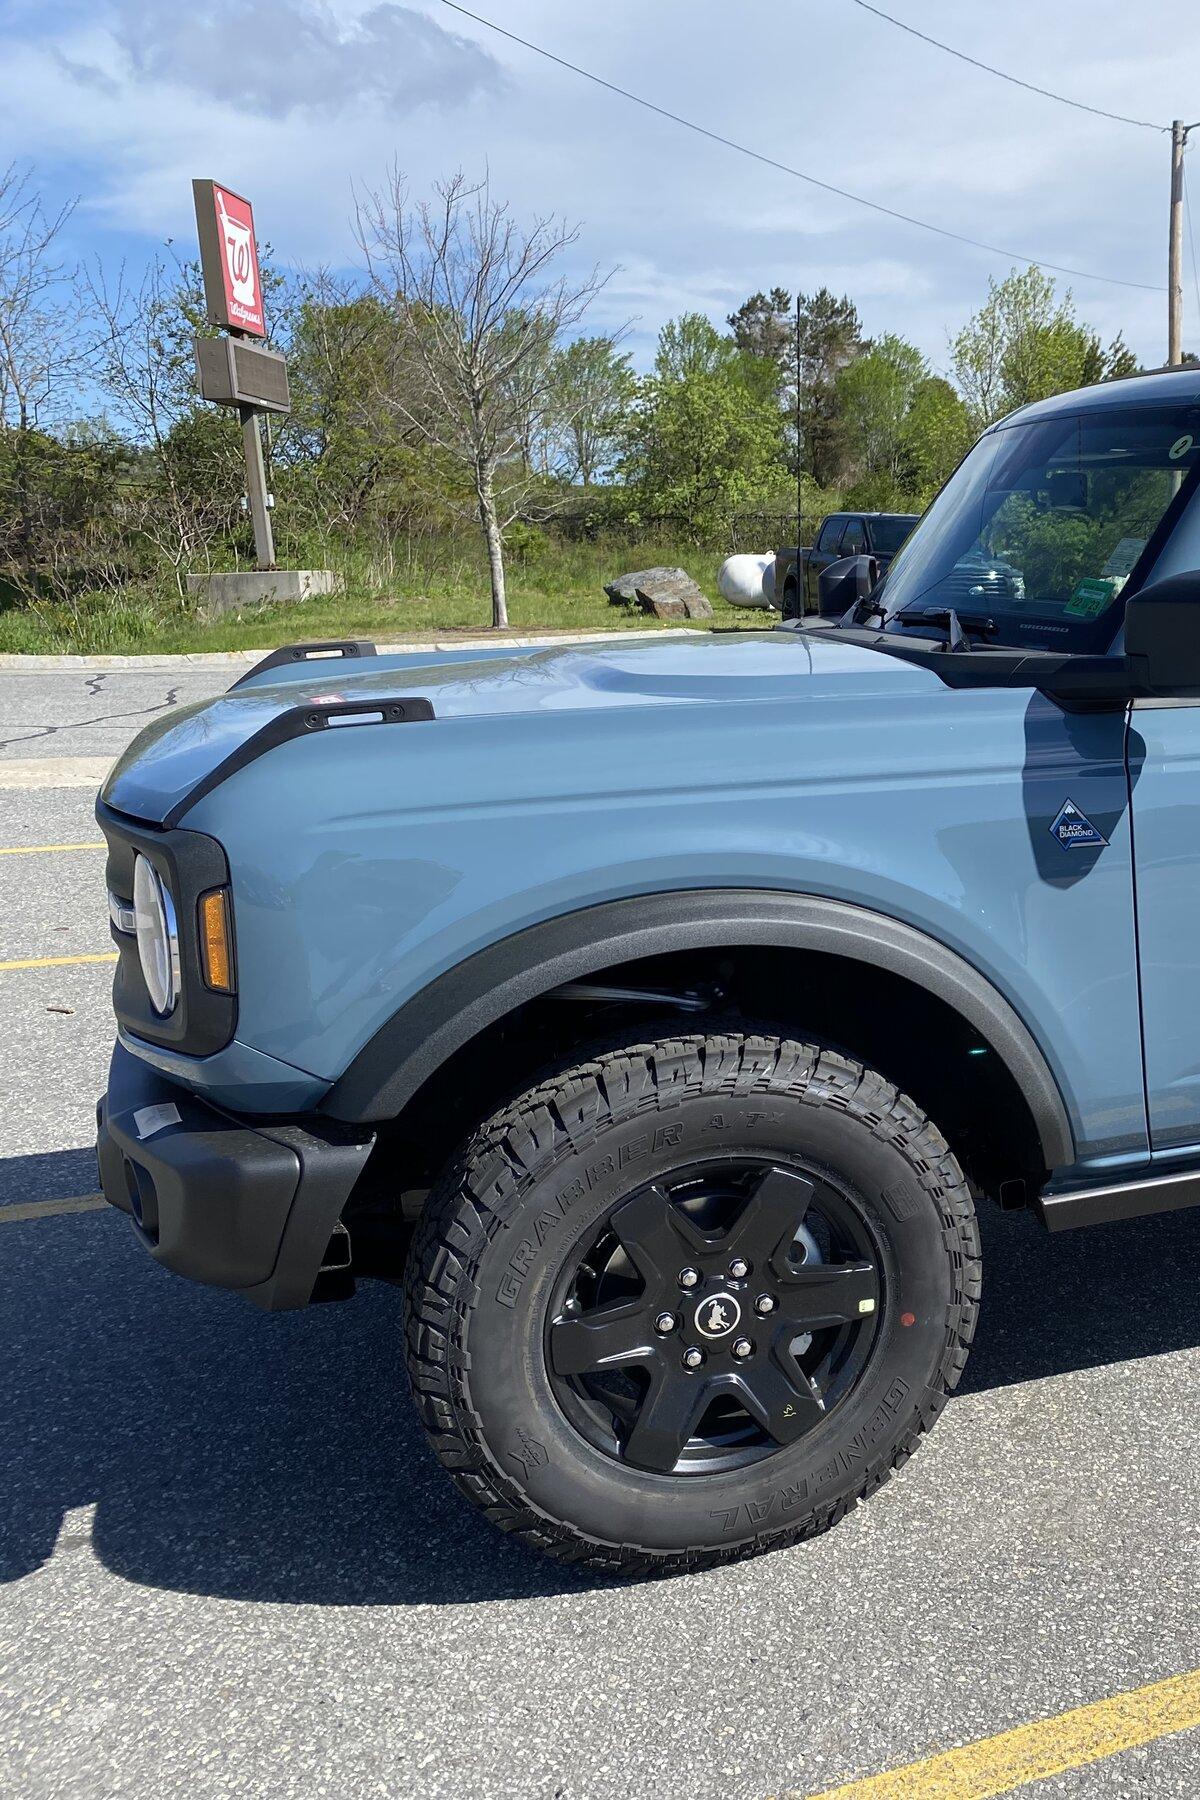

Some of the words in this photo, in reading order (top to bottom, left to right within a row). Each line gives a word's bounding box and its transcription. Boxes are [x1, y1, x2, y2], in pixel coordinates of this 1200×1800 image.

[1018, 623, 1070, 633] BRONCO
[1059, 824, 1083, 832] BLACK
[1059, 829, 1094, 838] DIAMOND
[495, 1121, 685, 1309] GRABBER
[709, 1376, 910, 1532] GENERAL
